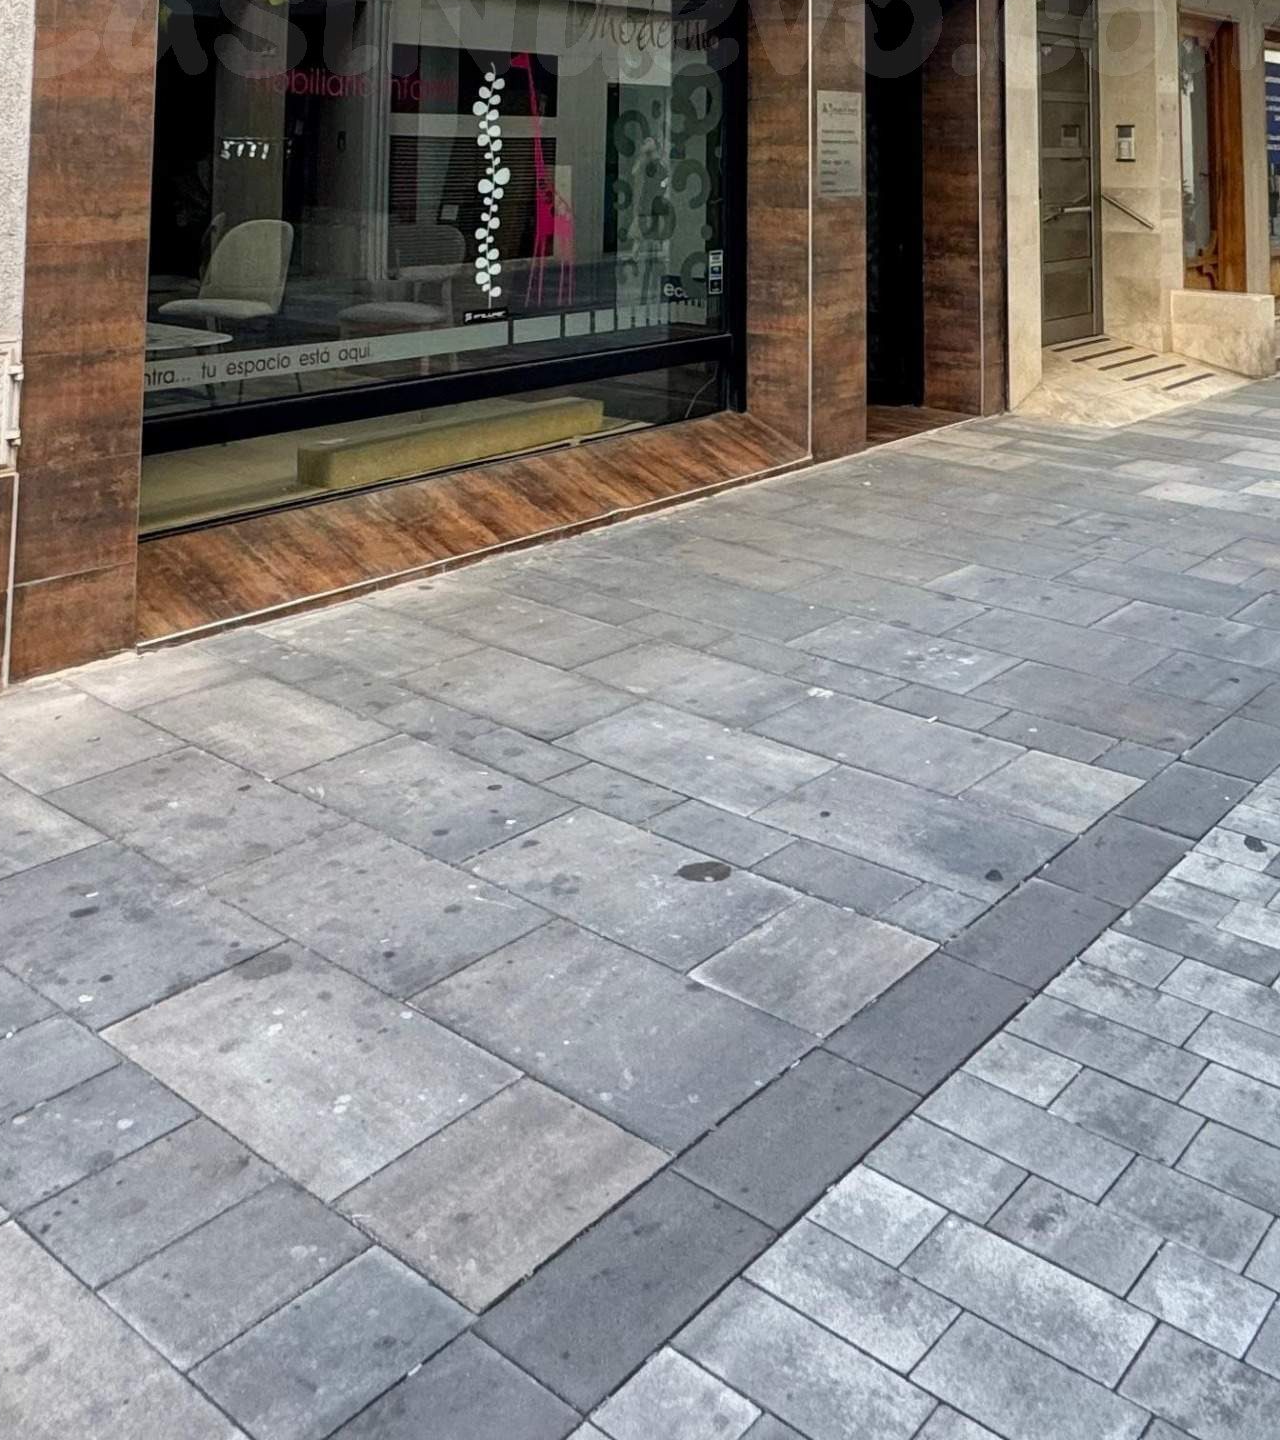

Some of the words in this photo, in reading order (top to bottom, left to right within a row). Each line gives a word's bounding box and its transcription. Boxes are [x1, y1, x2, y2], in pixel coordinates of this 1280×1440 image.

[200, 360, 217, 379] tu
[226, 353, 291, 377] espacio
[298, 348, 331, 367] está
